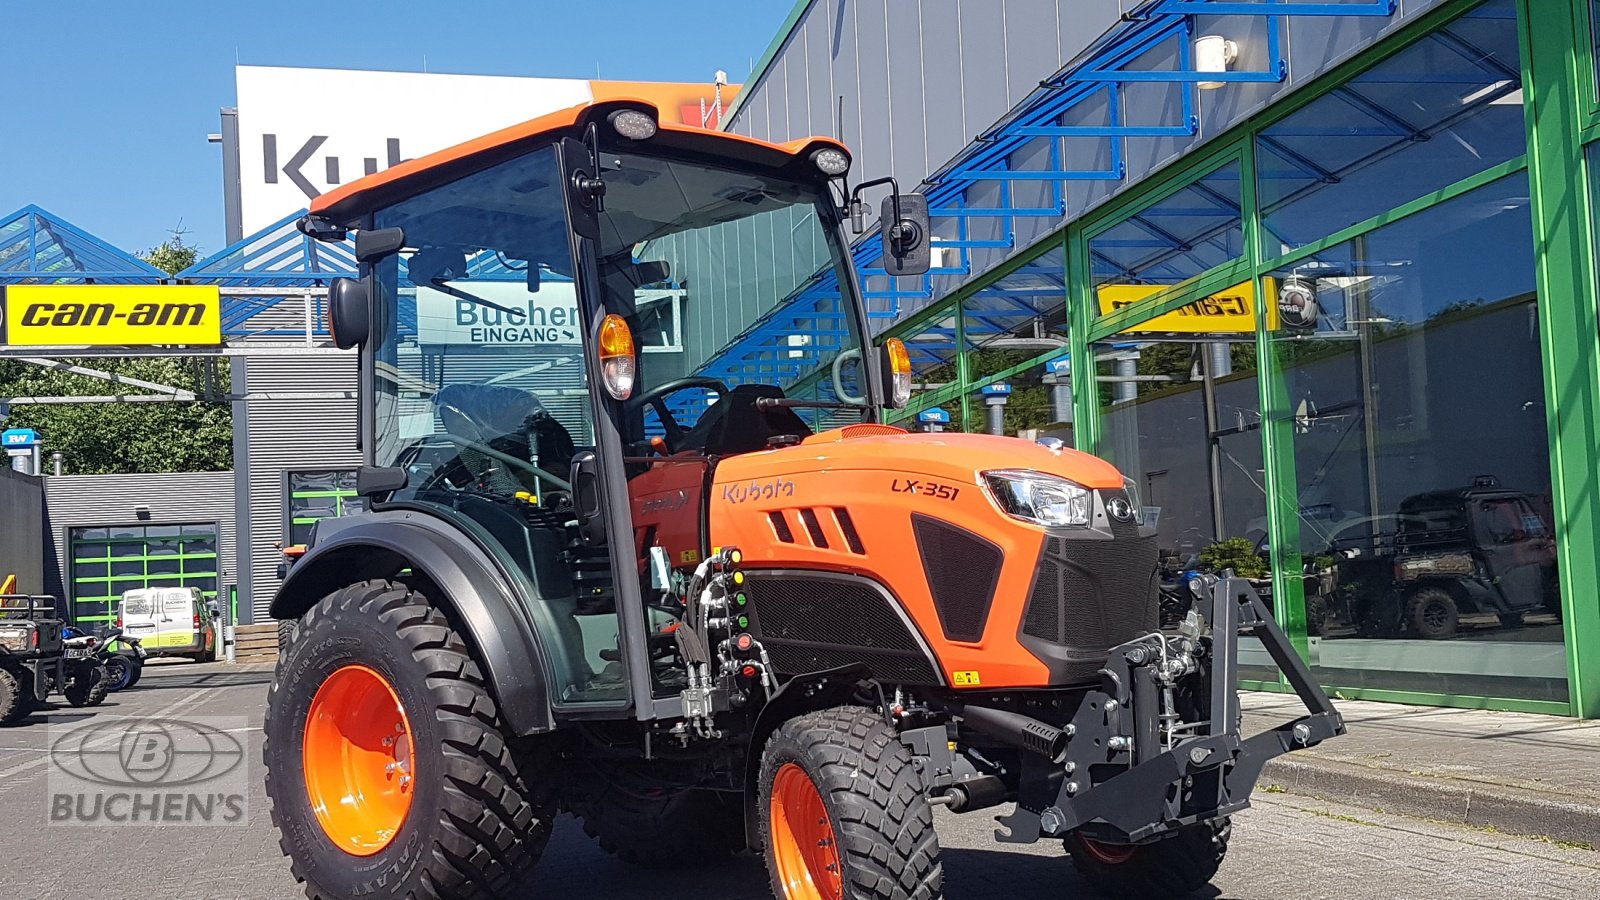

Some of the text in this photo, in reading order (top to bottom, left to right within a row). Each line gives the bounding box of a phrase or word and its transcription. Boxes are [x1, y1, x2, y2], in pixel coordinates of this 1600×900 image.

[21, 303, 207, 327] can-am
[471, 328, 559, 342] EINGANG
[722, 476, 795, 504] Kubota
[891, 478, 960, 501] LX-351
